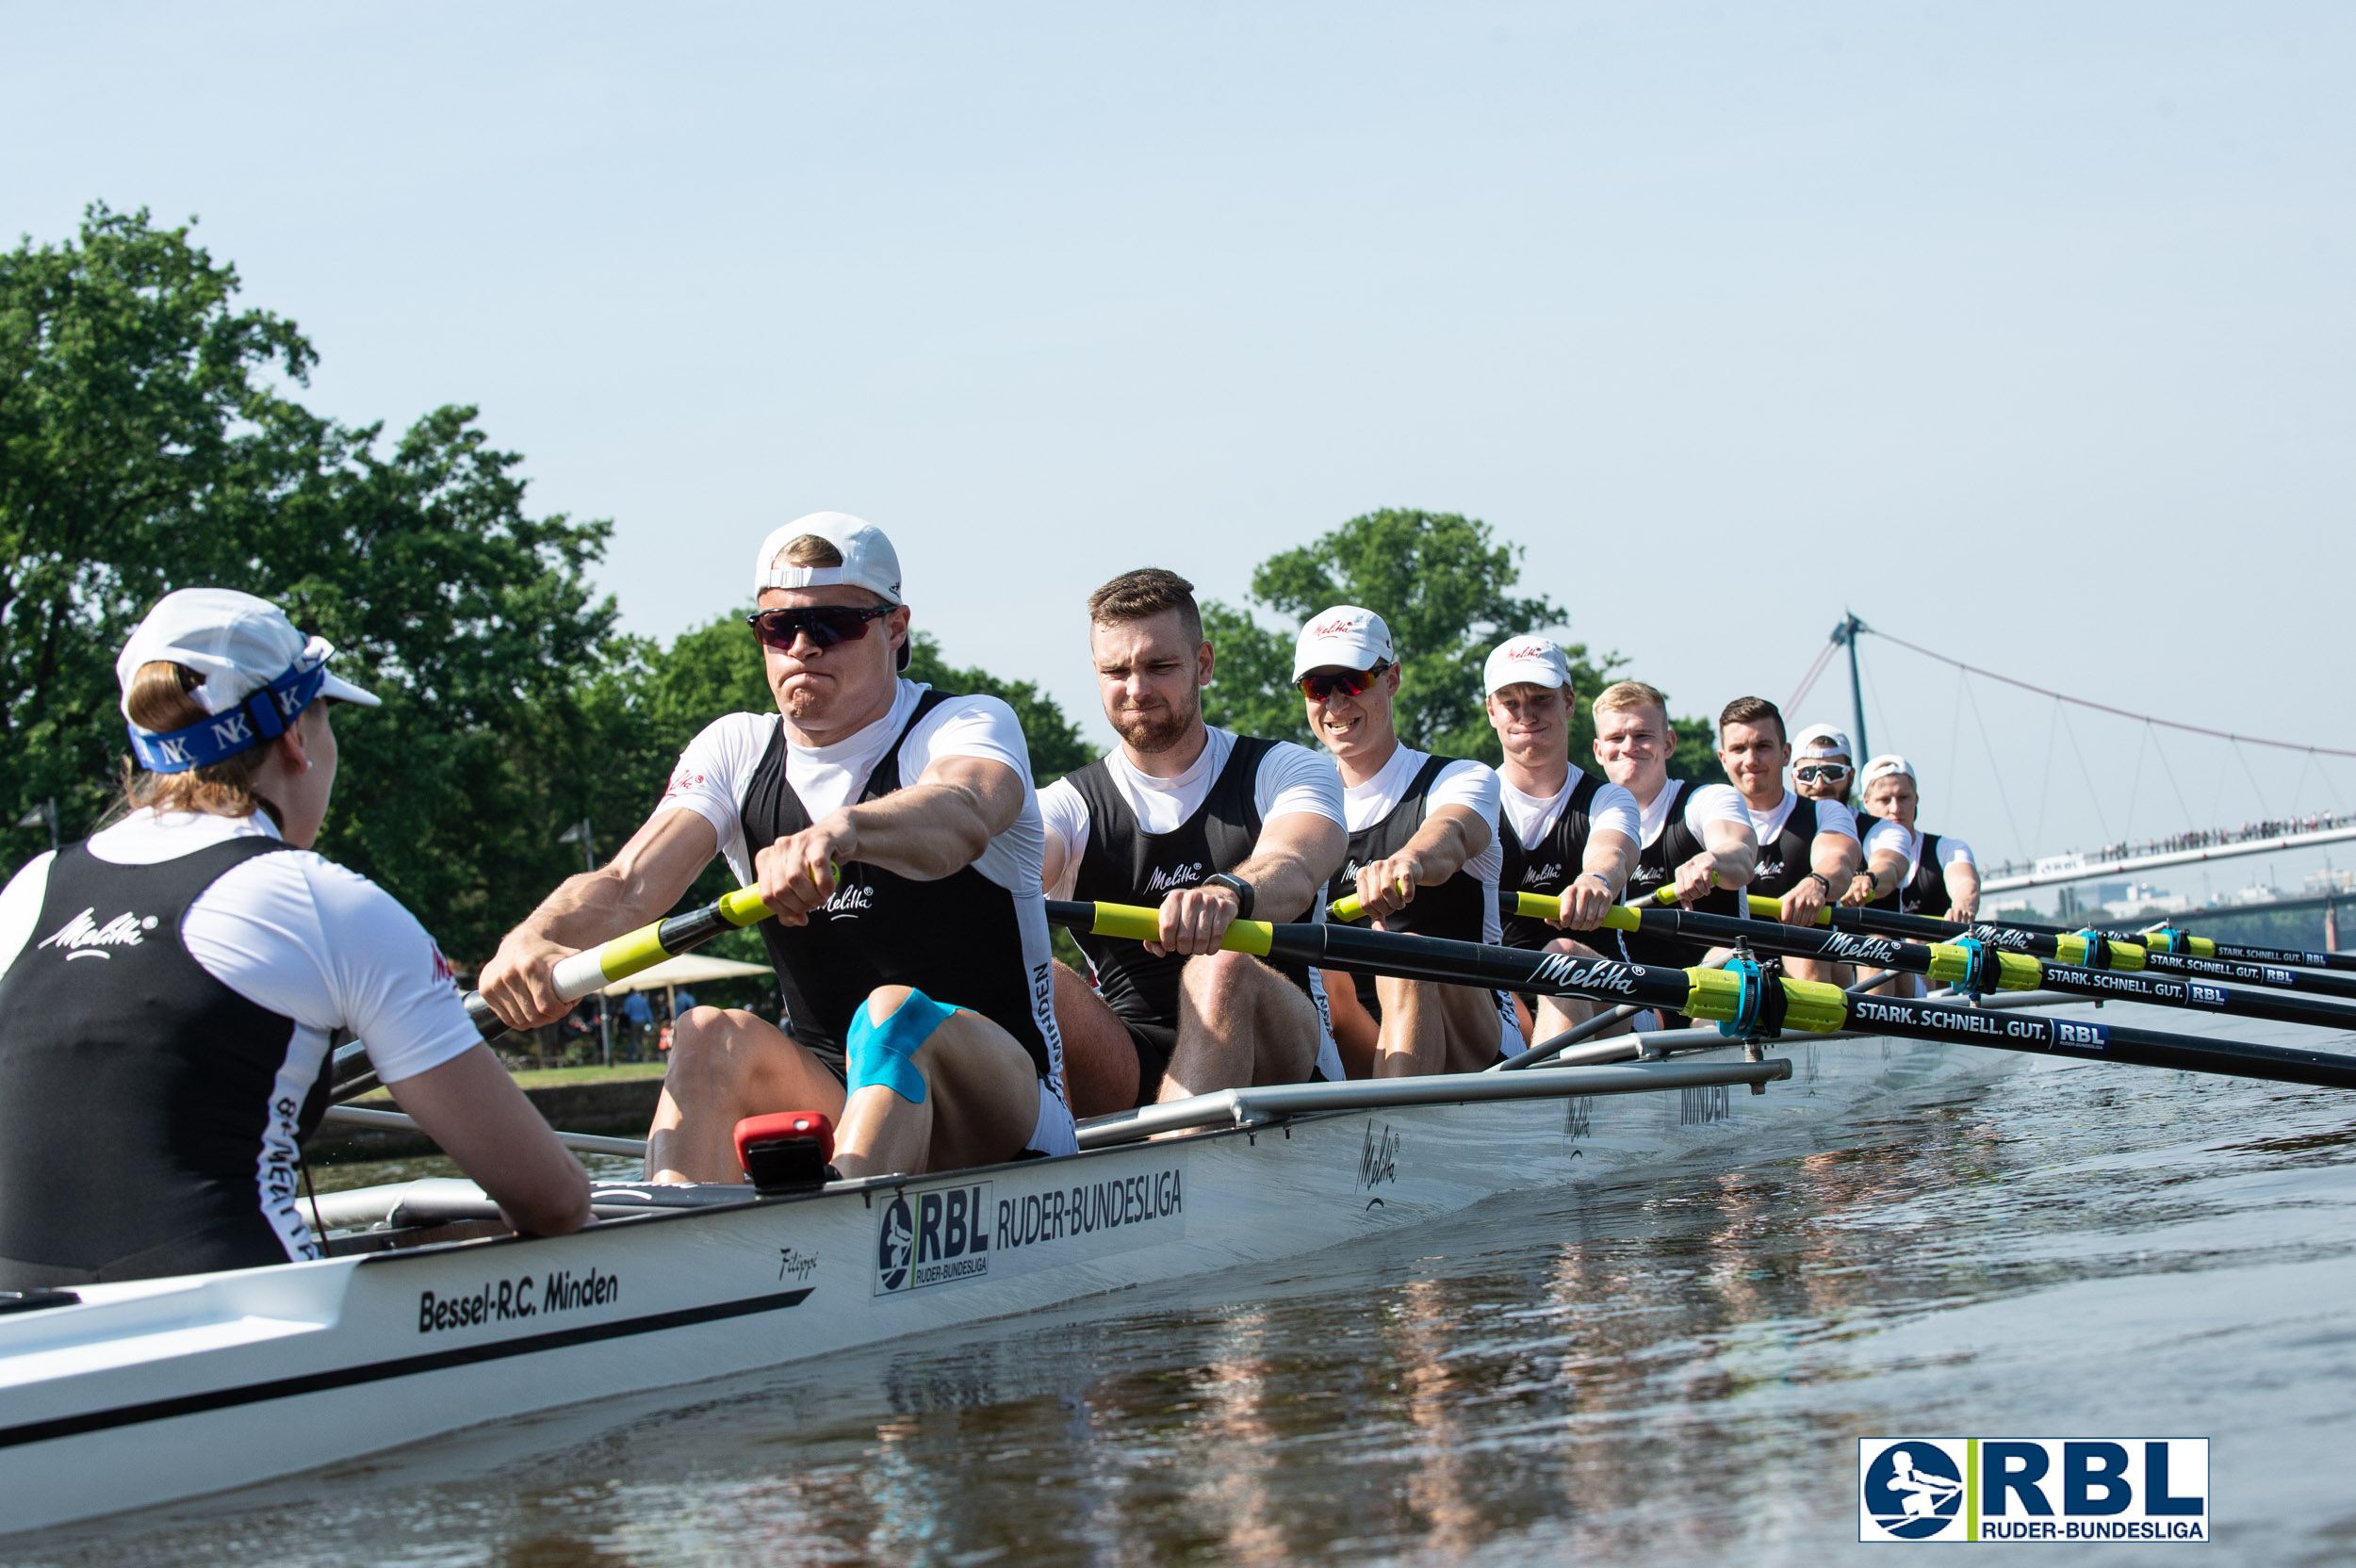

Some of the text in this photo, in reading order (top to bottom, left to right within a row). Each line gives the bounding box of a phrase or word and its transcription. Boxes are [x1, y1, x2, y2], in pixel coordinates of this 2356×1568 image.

[211, 712, 254, 750] NK
[157, 735, 198, 765] NK
[2151, 955, 2293, 982] STARK. SCHNELL. GUT. RBL
[2218, 946, 2326, 963] STARK. SCHNELL. GUT. RBL
[2048, 969, 2091, 986] STARK.
[2093, 975, 2152, 994] SCHNELL.
[2155, 984, 2184, 998] GUT.
[2192, 987, 2225, 1002] RBL
[1033, 962, 1061, 1063] MINDEN
[1856, 1002, 2104, 1045] STARK. SCHNELL. GUT. RBL
[917, 1169, 1182, 1264] RBL RUDER-BUNDESLIGA
[778, 1247, 819, 1282] Filippi
[916, 1256, 987, 1284] RUDER-BUNDESLIGA
[419, 1266, 618, 1333] Bessel-R.C. Minden
